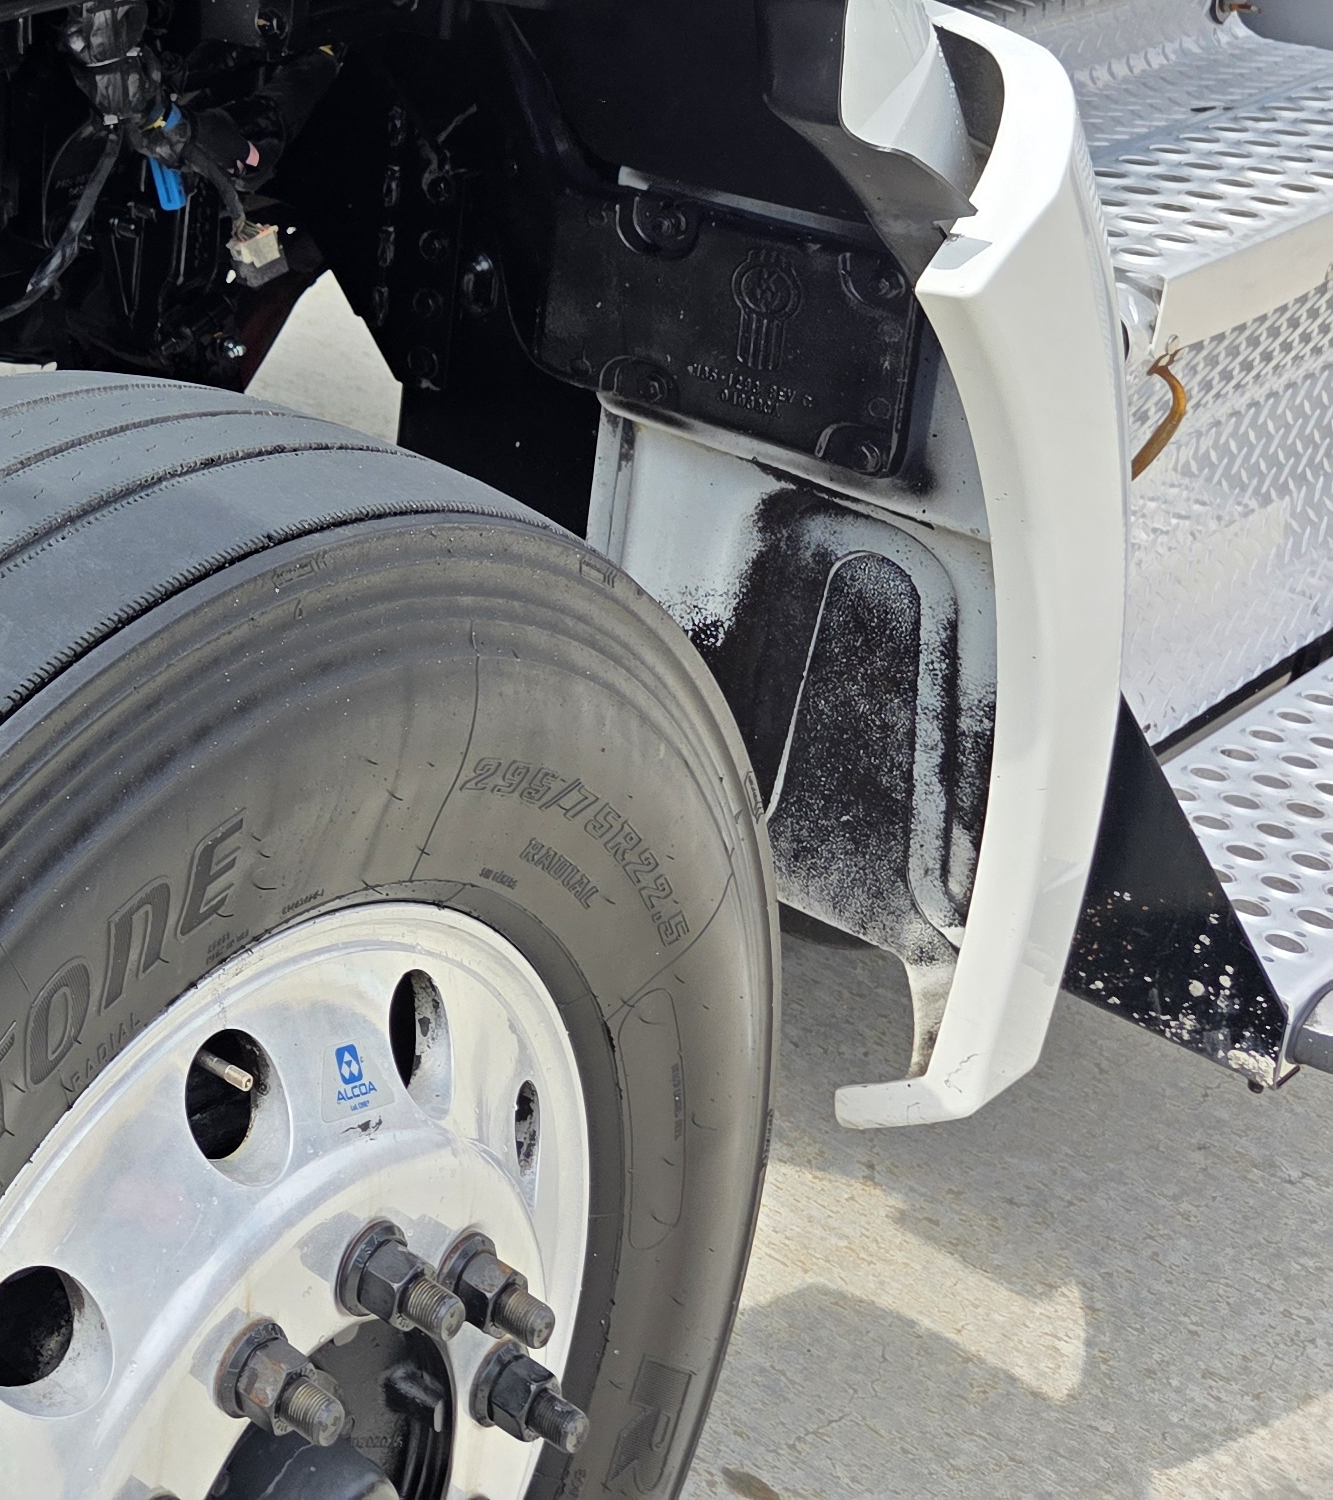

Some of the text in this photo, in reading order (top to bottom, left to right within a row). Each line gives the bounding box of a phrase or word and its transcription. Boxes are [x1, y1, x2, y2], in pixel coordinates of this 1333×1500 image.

[459, 756, 692, 948] 295/75R22.5
[520, 836, 607, 910] RADIAL
[70, 1013, 145, 1092] RADIAL
[336, 1080, 378, 1102] ALCOA
